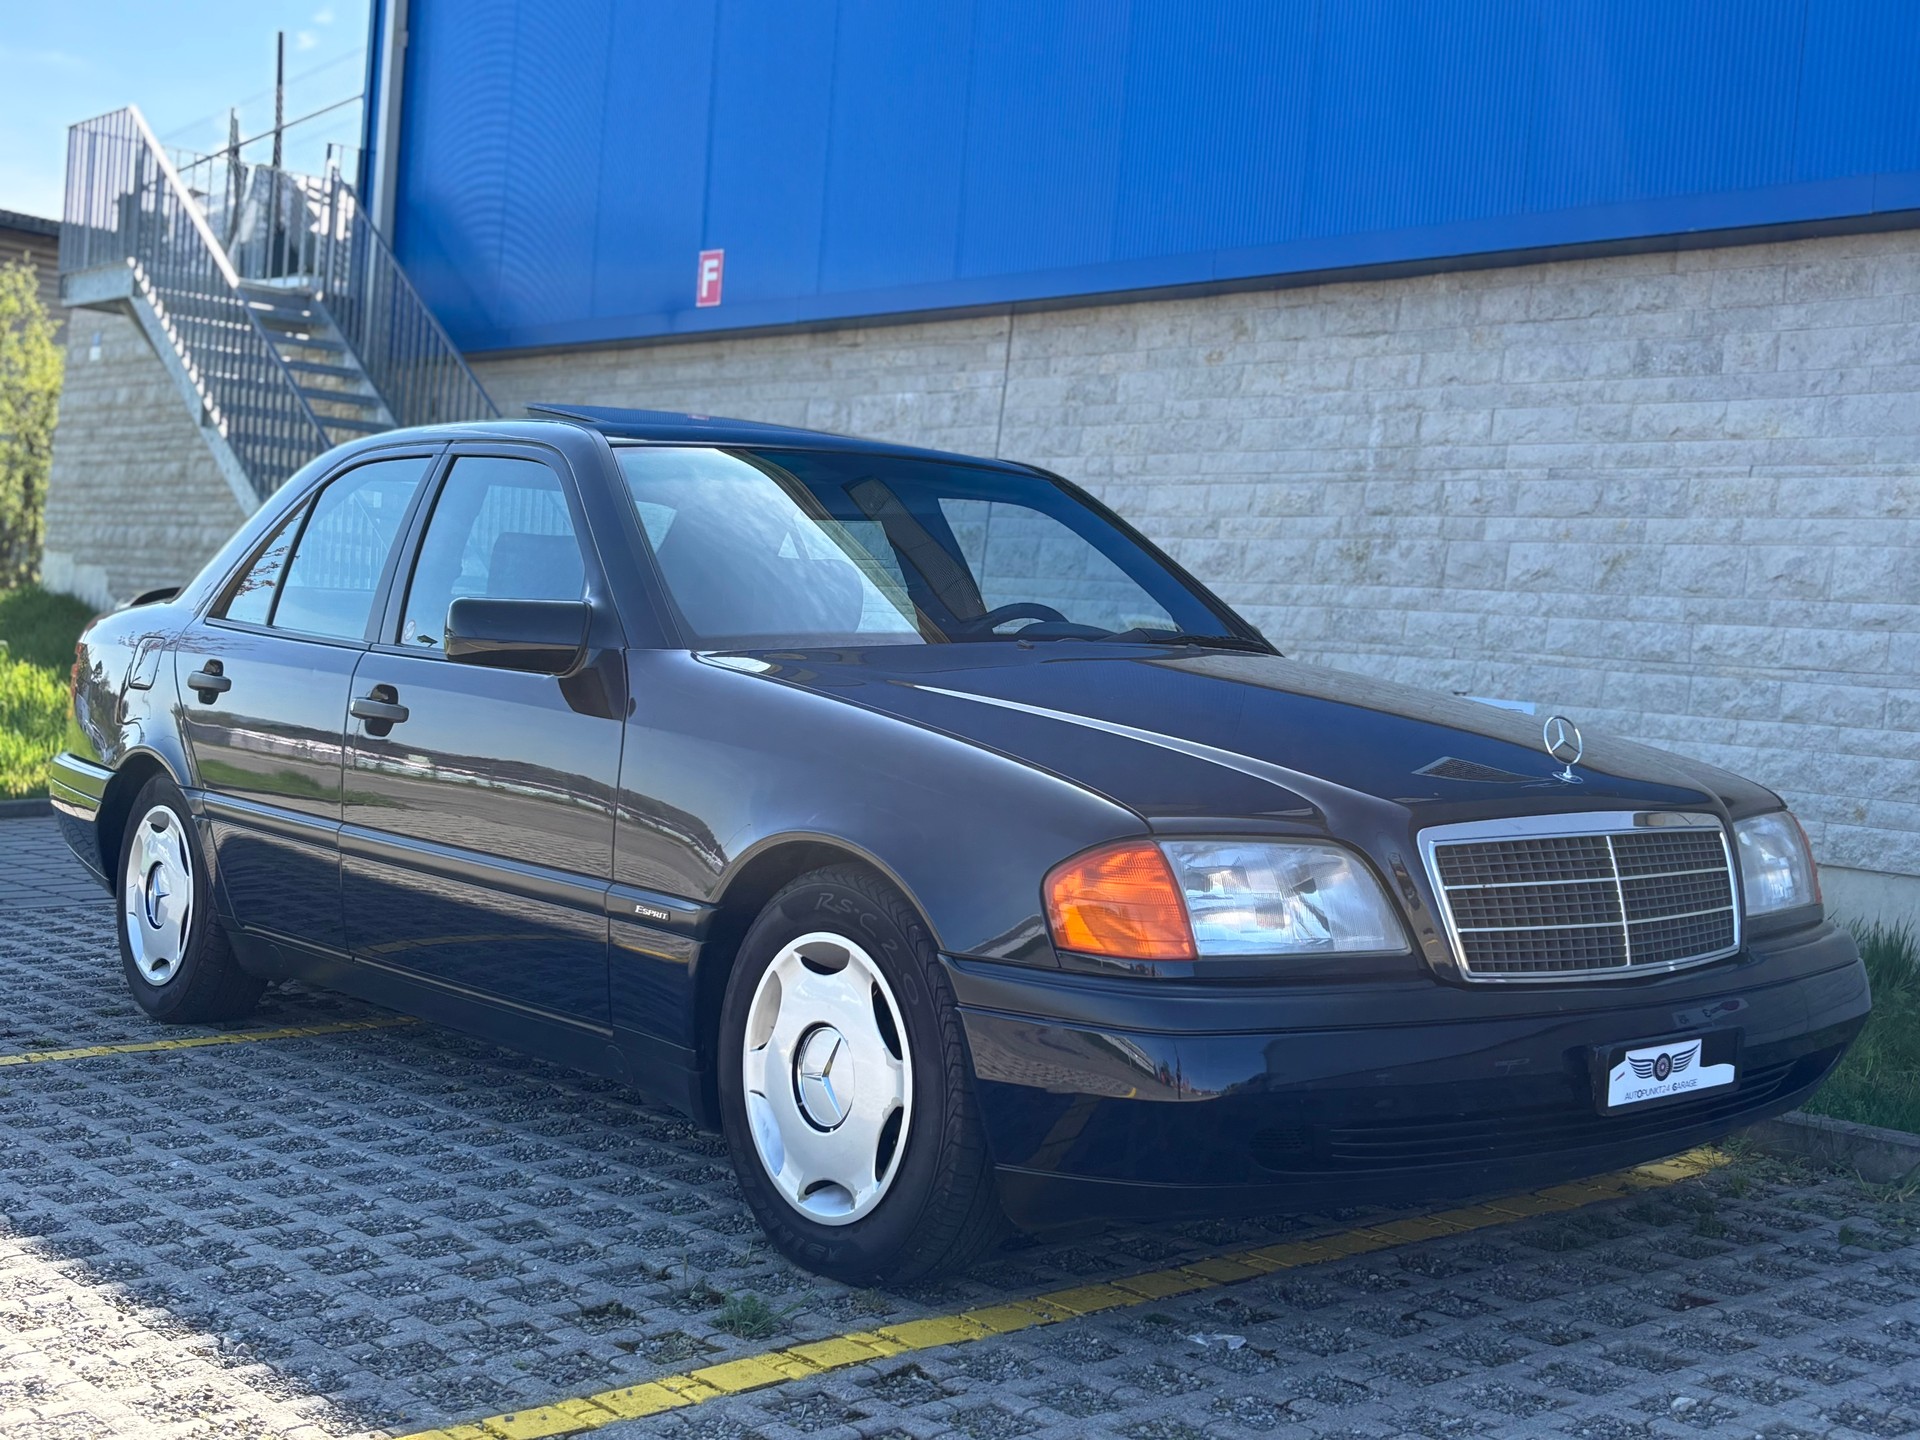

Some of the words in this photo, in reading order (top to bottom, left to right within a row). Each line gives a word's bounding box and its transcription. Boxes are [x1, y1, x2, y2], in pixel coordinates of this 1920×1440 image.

[701, 258, 719, 298] F
[635, 905, 668, 920] ESPRIT
[1672, 1078, 1698, 1091] GARAGE
